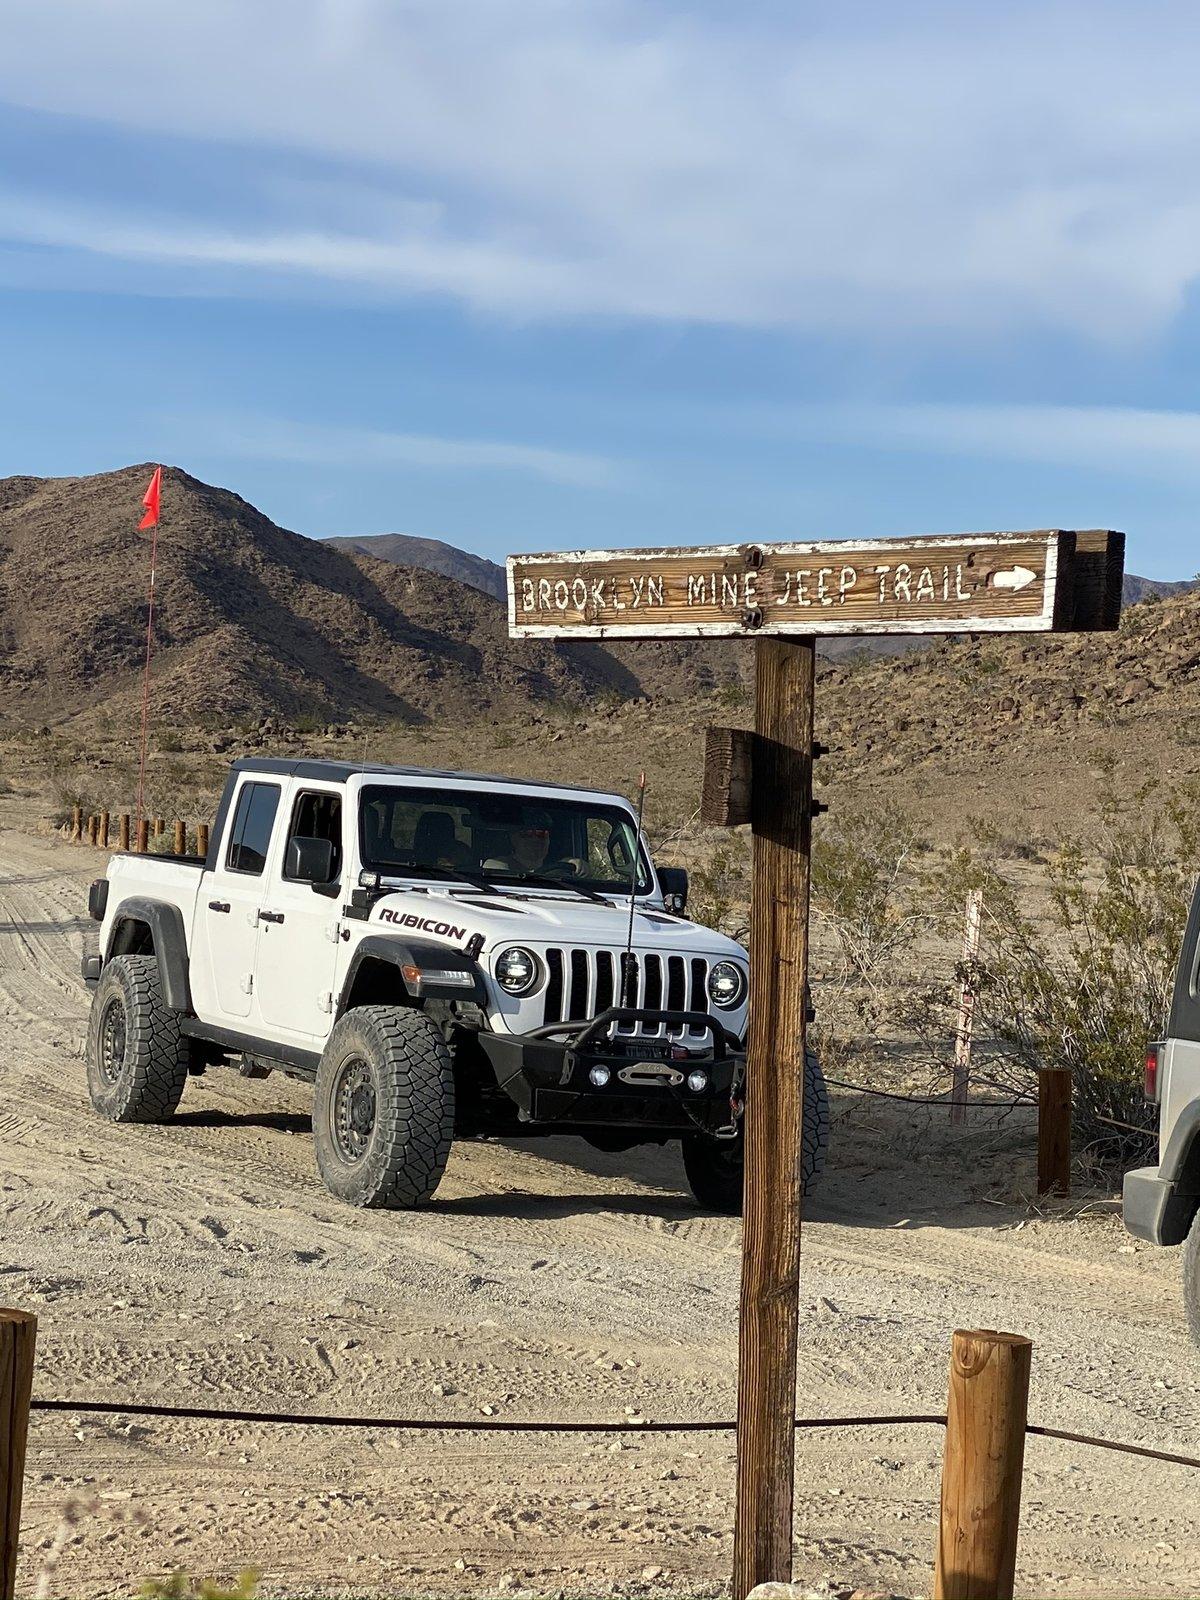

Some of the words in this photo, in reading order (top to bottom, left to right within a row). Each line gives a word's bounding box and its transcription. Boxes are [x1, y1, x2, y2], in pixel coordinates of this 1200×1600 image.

[521, 574, 664, 612] BROOKLYN
[687, 571, 758, 609] MINE
[776, 565, 858, 606] JEEP
[871, 562, 972, 604] TRAIL
[379, 908, 467, 940] RUBICON
